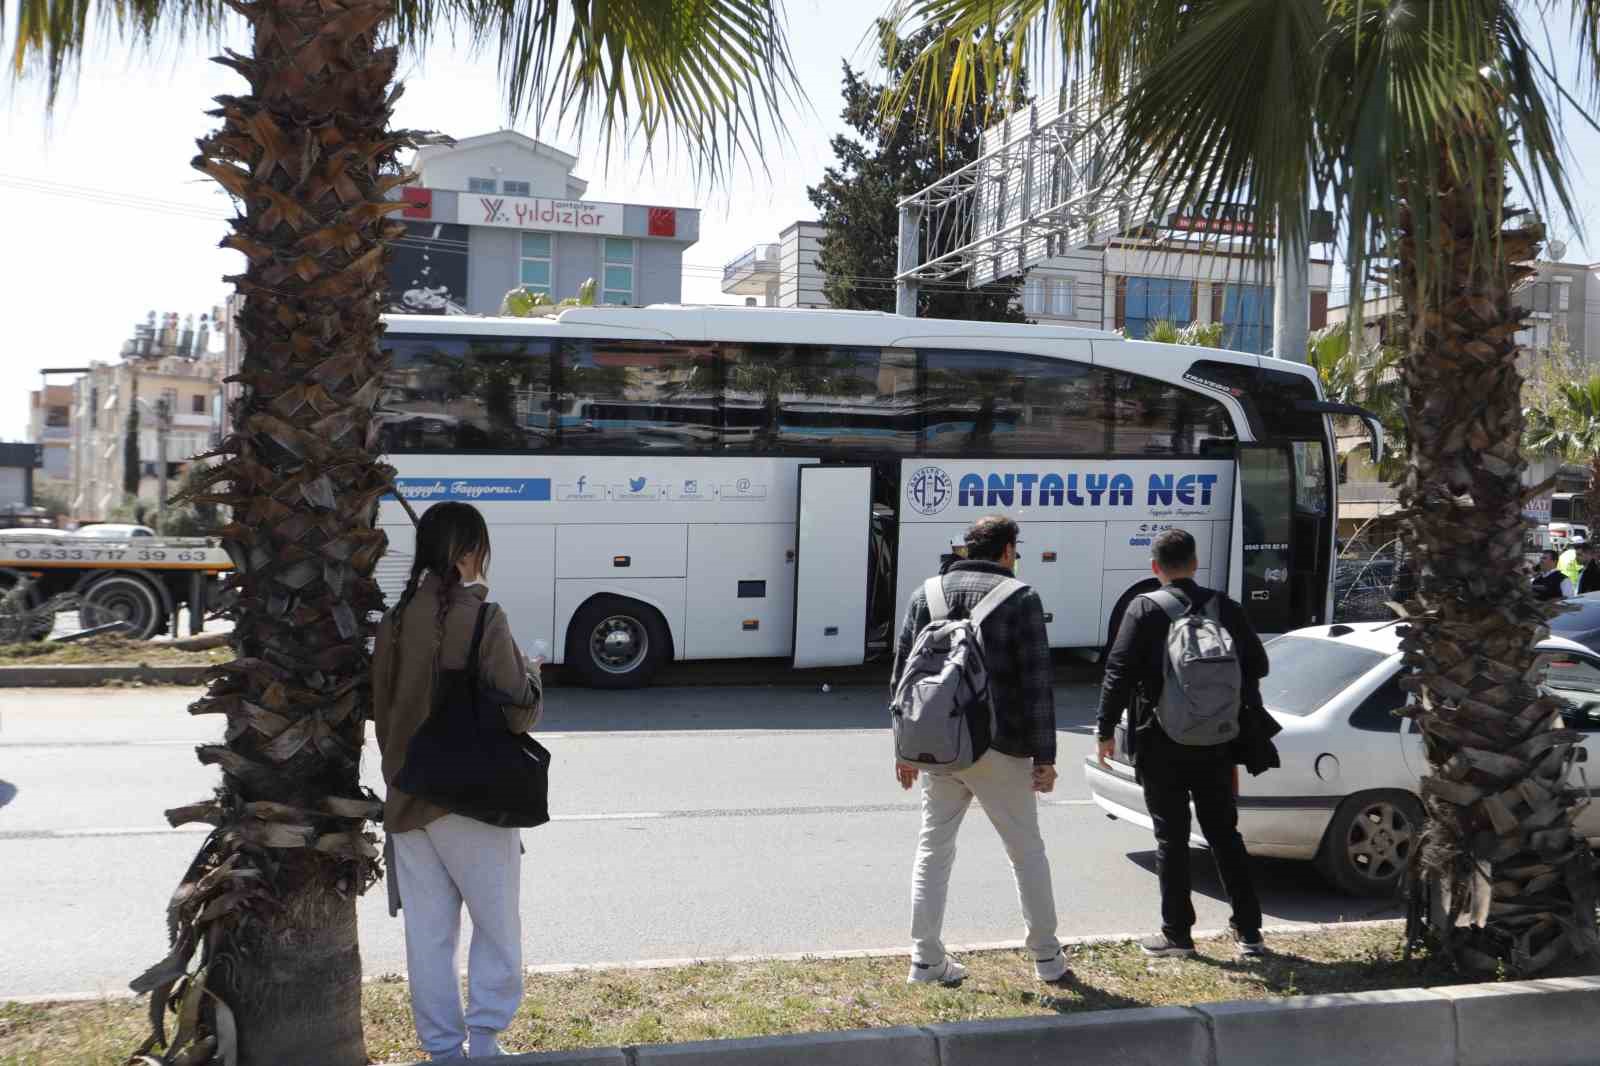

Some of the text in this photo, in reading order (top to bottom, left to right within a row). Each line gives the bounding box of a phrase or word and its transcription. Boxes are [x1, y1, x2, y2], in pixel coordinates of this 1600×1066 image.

[1185, 373, 1231, 391] TRAVEGO
[958, 473, 1218, 507] ANTALYA NET
[137, 550, 167, 562] 39
[177, 550, 207, 562] 63
